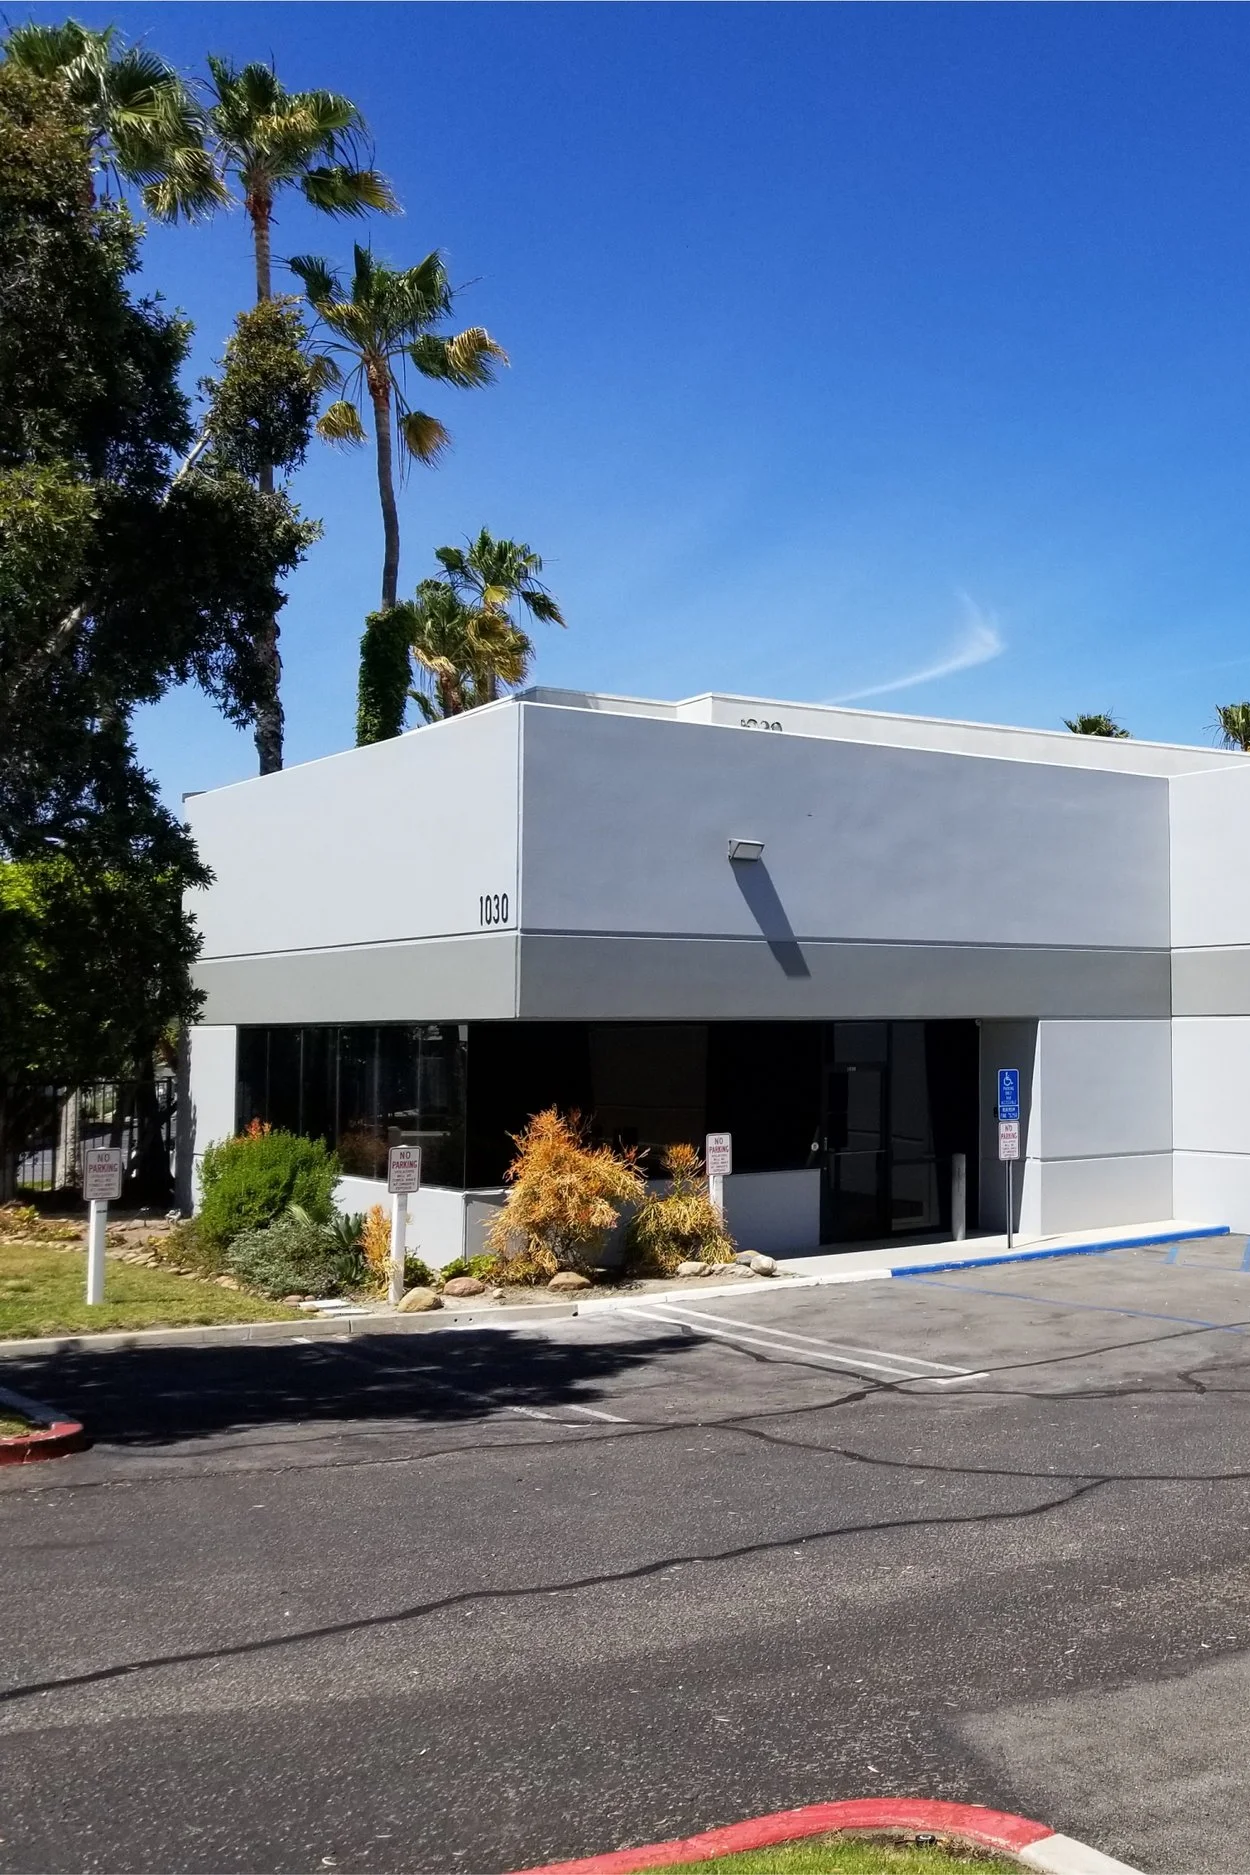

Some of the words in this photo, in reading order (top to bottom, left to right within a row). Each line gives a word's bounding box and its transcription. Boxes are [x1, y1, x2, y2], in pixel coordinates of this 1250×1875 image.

[480, 893, 509, 926] 1030
[714, 1137, 724, 1145] NO
[97, 1153, 110, 1163] NO
[399, 1151, 411, 1160] NO
[88, 1163, 119, 1173] PARKING
[392, 1160, 418, 1170] PARKING
